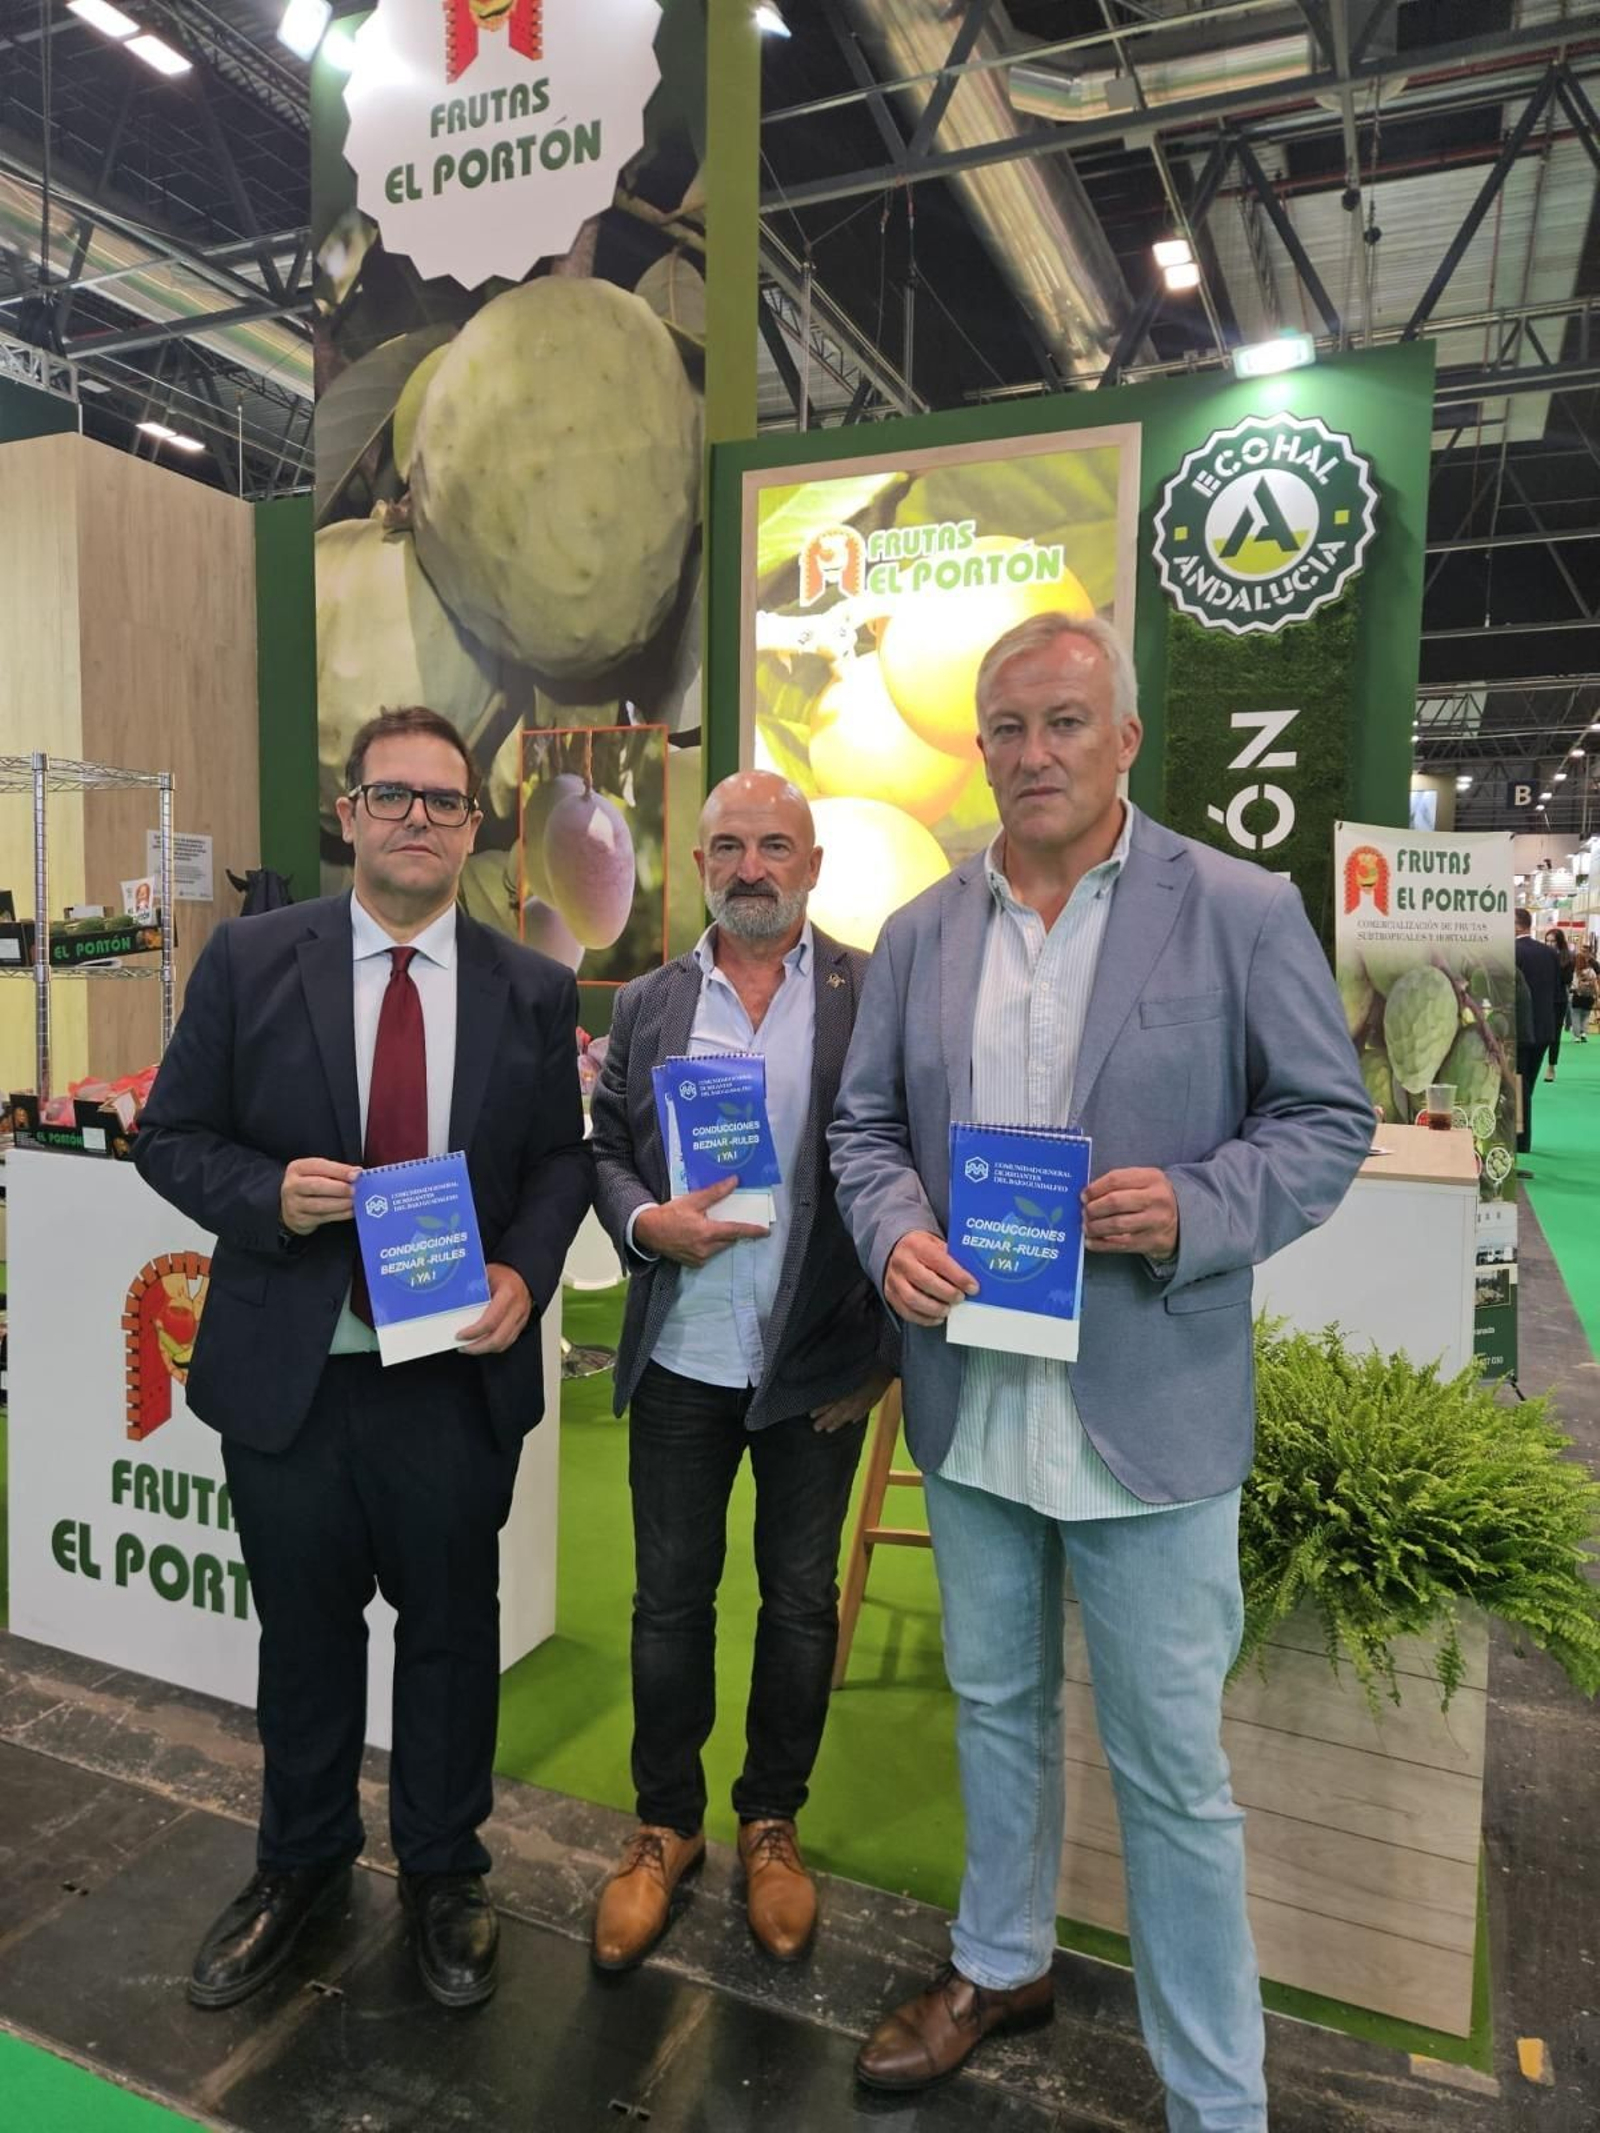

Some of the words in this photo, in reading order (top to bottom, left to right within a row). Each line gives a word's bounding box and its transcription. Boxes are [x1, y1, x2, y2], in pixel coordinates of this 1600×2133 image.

[430, 77, 551, 138] FRUTAS
[385, 163, 422, 204] EL
[433, 115, 602, 196] PORTÓN
[1191, 433, 1340, 498] ECOHAL
[867, 521, 976, 559] FRUTAS
[869, 562, 902, 594] EL
[1172, 541, 1347, 612] ANDALUCIA
[1514, 785, 1531, 806] B
[1397, 849, 1471, 875] FRUTAS
[1397, 887, 1415, 910] EL
[1422, 884, 1507, 913] PORTÓN
[53, 947, 69, 959] EL
[76, 935, 131, 956] PORTÓN
[692, 1120, 760, 1137] CONDUCCIONES
[693, 1137, 728, 1150] BEZNAR
[962, 1235, 1011, 1253] BEZNAR
[966, 1217, 1066, 1243] CONDUCCIONES
[380, 1232, 468, 1259] CONDUCCIONES
[381, 1257, 425, 1276] BEZNAR
[112, 1459, 240, 1533] FRUTA
[52, 1519, 101, 1580] EL
[115, 1532, 251, 1621] PORT
